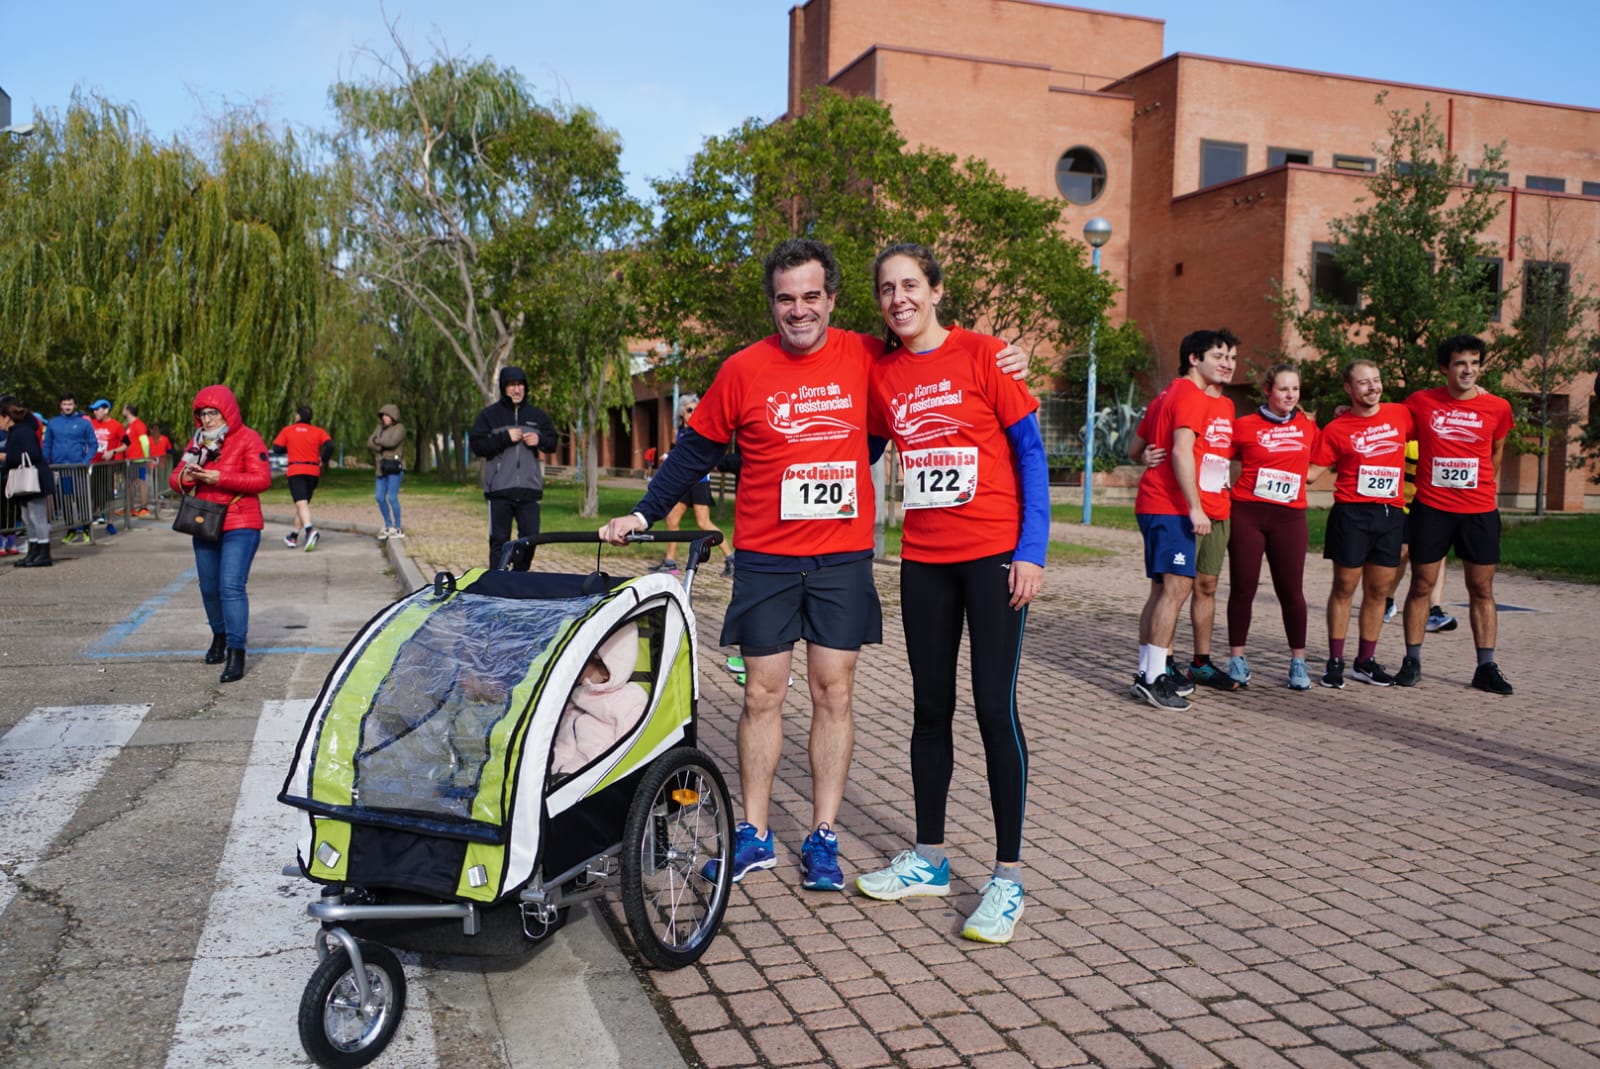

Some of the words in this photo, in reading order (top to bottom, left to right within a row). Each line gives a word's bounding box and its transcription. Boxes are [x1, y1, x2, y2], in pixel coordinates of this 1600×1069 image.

[798, 385, 826, 400] ¡Corre
[826, 382, 841, 396] sin
[939, 378, 951, 392] sin
[794, 394, 853, 414] resistencias!
[909, 389, 963, 414] resistencias!
[917, 469, 960, 493] 122
[1368, 477, 1393, 490] 287
[1441, 468, 1469, 481] 320
[800, 482, 842, 504] 120
[1266, 480, 1291, 494] 110
